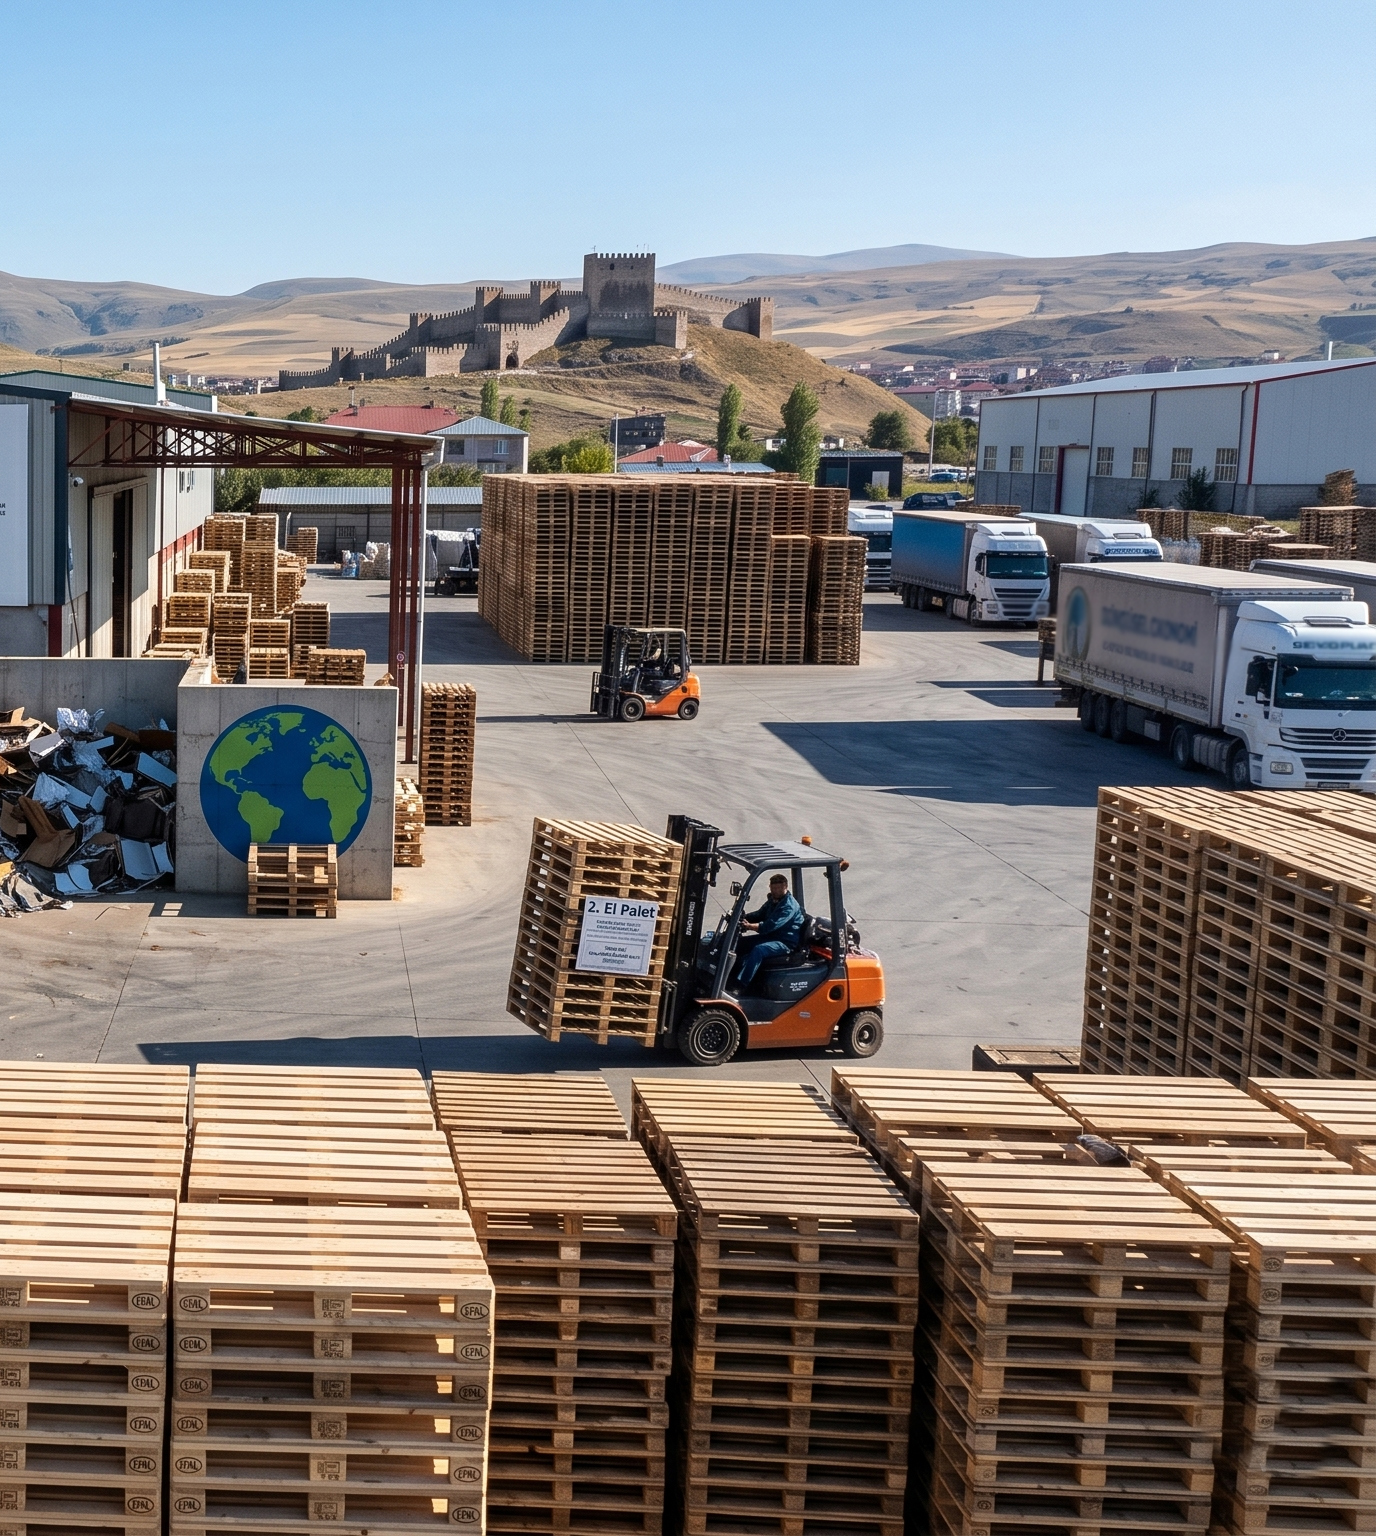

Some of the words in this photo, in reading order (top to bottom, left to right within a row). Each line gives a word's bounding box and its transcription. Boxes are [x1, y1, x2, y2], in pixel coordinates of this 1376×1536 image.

[587, 901, 600, 914] 2.
[604, 902, 617, 915] El
[620, 903, 655, 919] Palet
